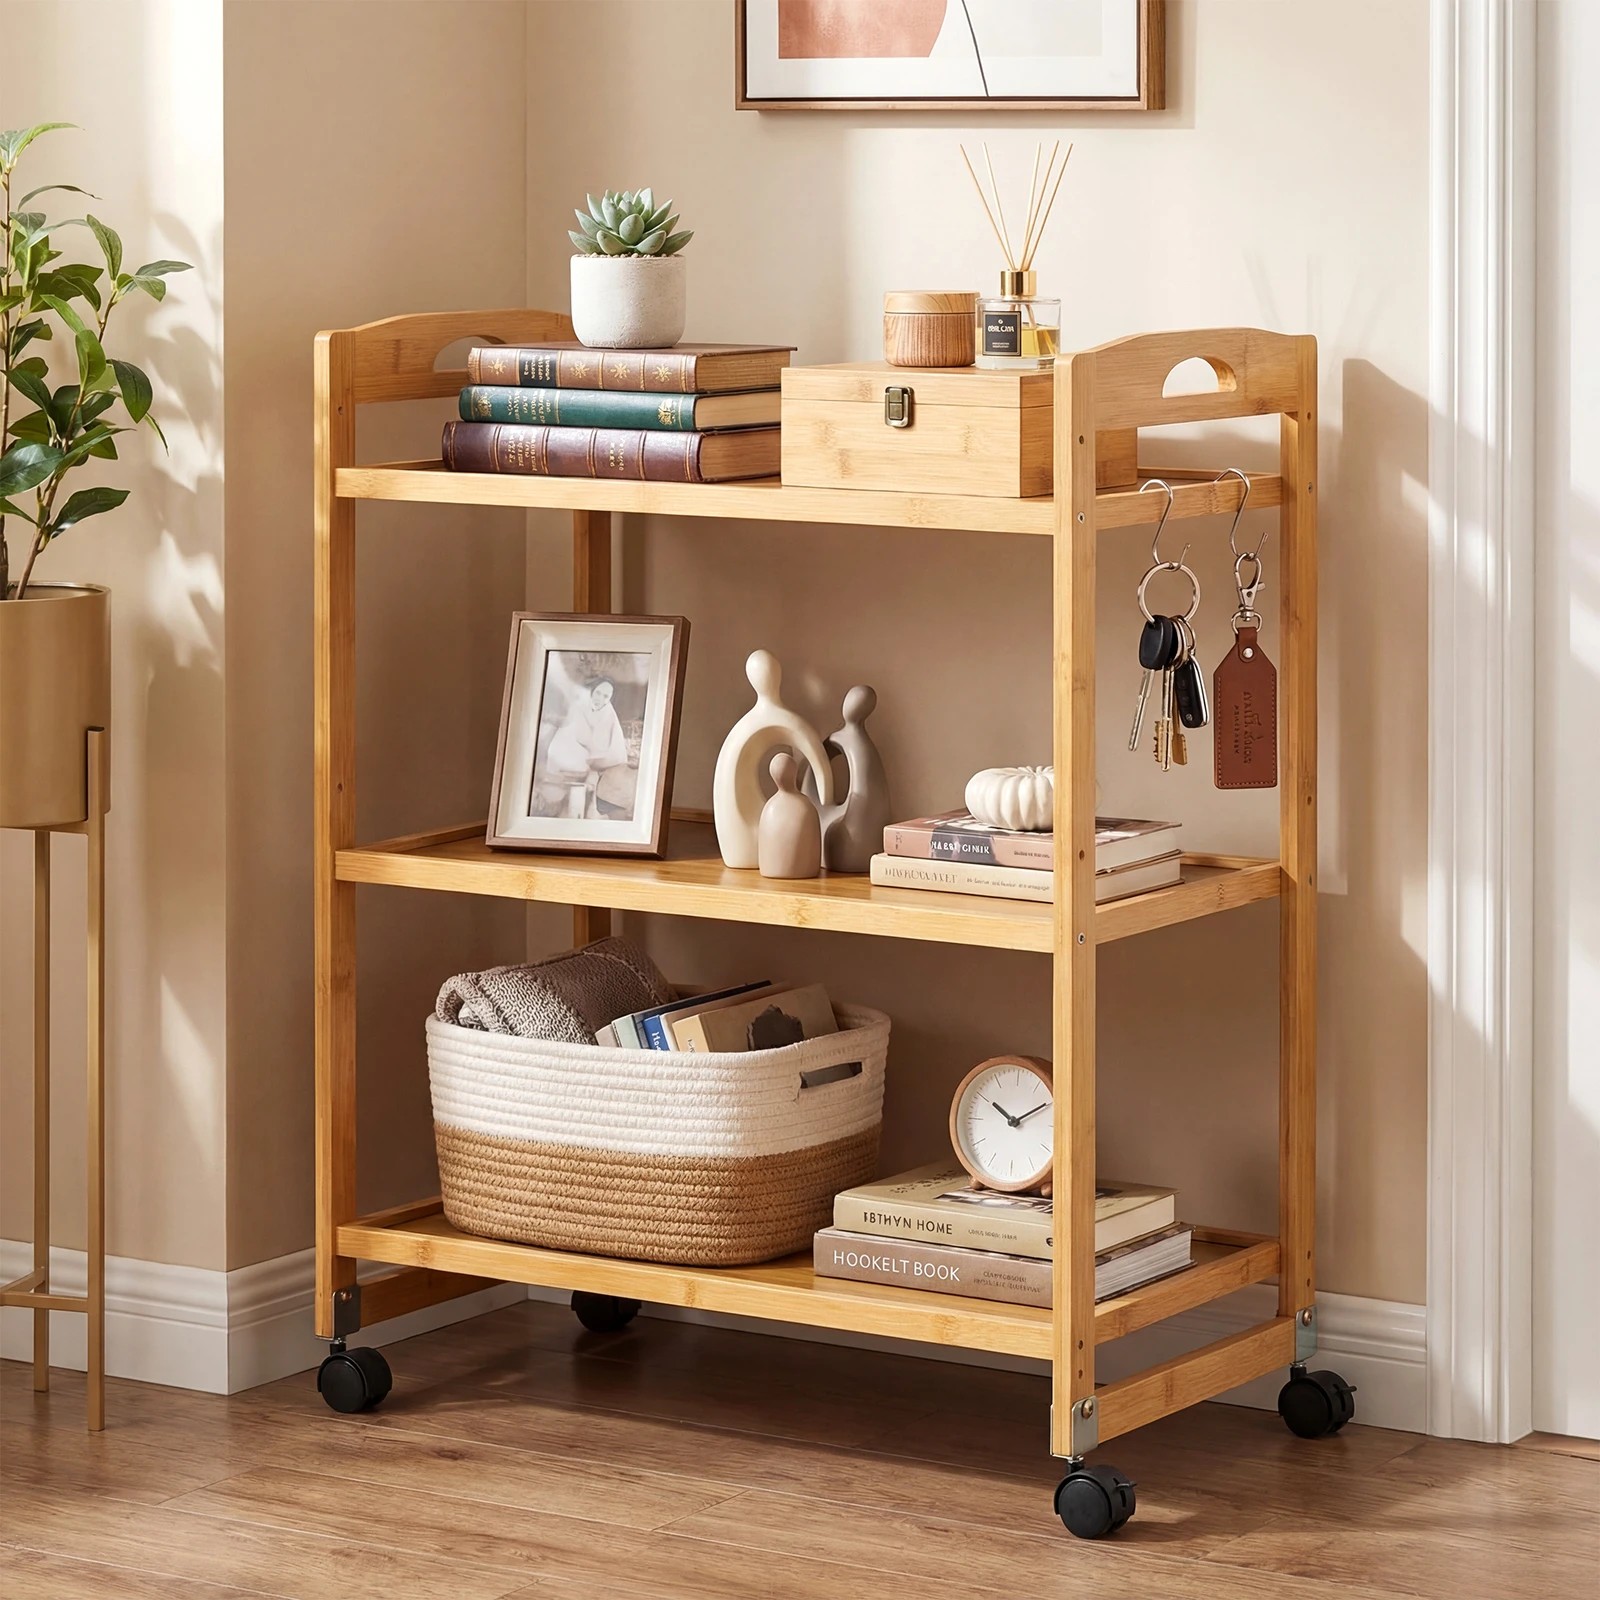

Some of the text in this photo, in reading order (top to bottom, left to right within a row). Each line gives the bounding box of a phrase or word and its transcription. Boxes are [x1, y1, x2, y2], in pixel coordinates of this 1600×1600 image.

[917, 1219, 953, 1235] HOME
[833, 1249, 910, 1274] HOOKELT
[913, 1261, 960, 1282] BOOK
